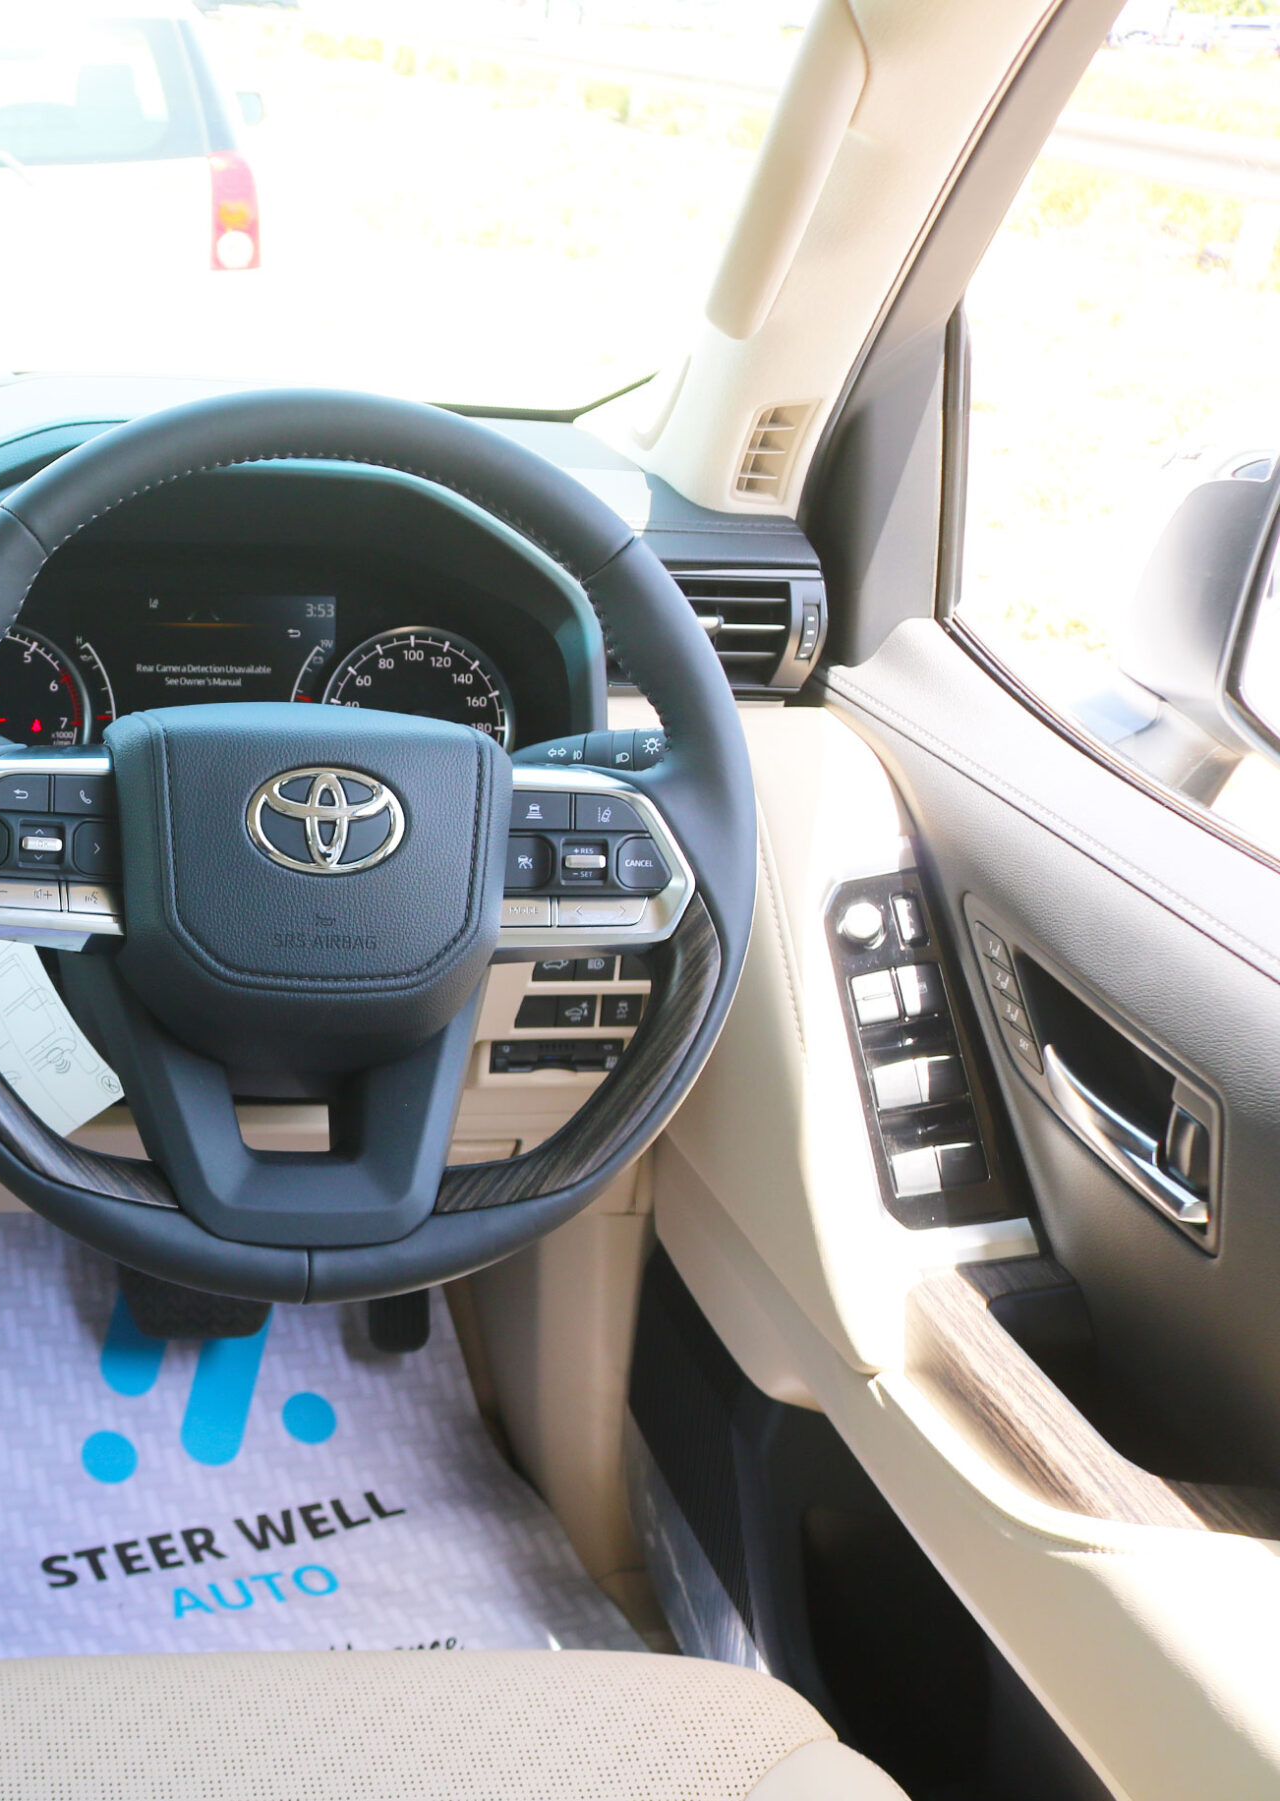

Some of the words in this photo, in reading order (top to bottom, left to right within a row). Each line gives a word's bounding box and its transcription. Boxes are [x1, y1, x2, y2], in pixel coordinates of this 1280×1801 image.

[305, 603, 335, 618] 3:53
[23, 652, 33, 664] 5
[403, 649, 424, 662] 100
[378, 658, 395, 670] 80
[430, 656, 452, 668] 120
[136, 663, 155, 673] Rear
[156, 663, 187, 673] Camera
[187, 664, 225, 673] Detection
[225, 664, 272, 674] Unavailable
[165, 677, 180, 686] See
[180, 677, 213, 686] Owner's
[213, 677, 242, 687] Manual
[355, 675, 372, 687] 60
[452, 673, 473, 685] 140
[49, 680, 59, 692] 6
[466, 695, 488, 708] 160
[59, 716, 68, 729] 7
[624, 859, 654, 868] CANCEL
[272, 934, 307, 948] SRS
[312, 935, 377, 951] AIRBAG
[40, 1525, 228, 1589] STEER
[233, 1490, 407, 1552] WELL
[172, 1563, 340, 1619] AUTO
